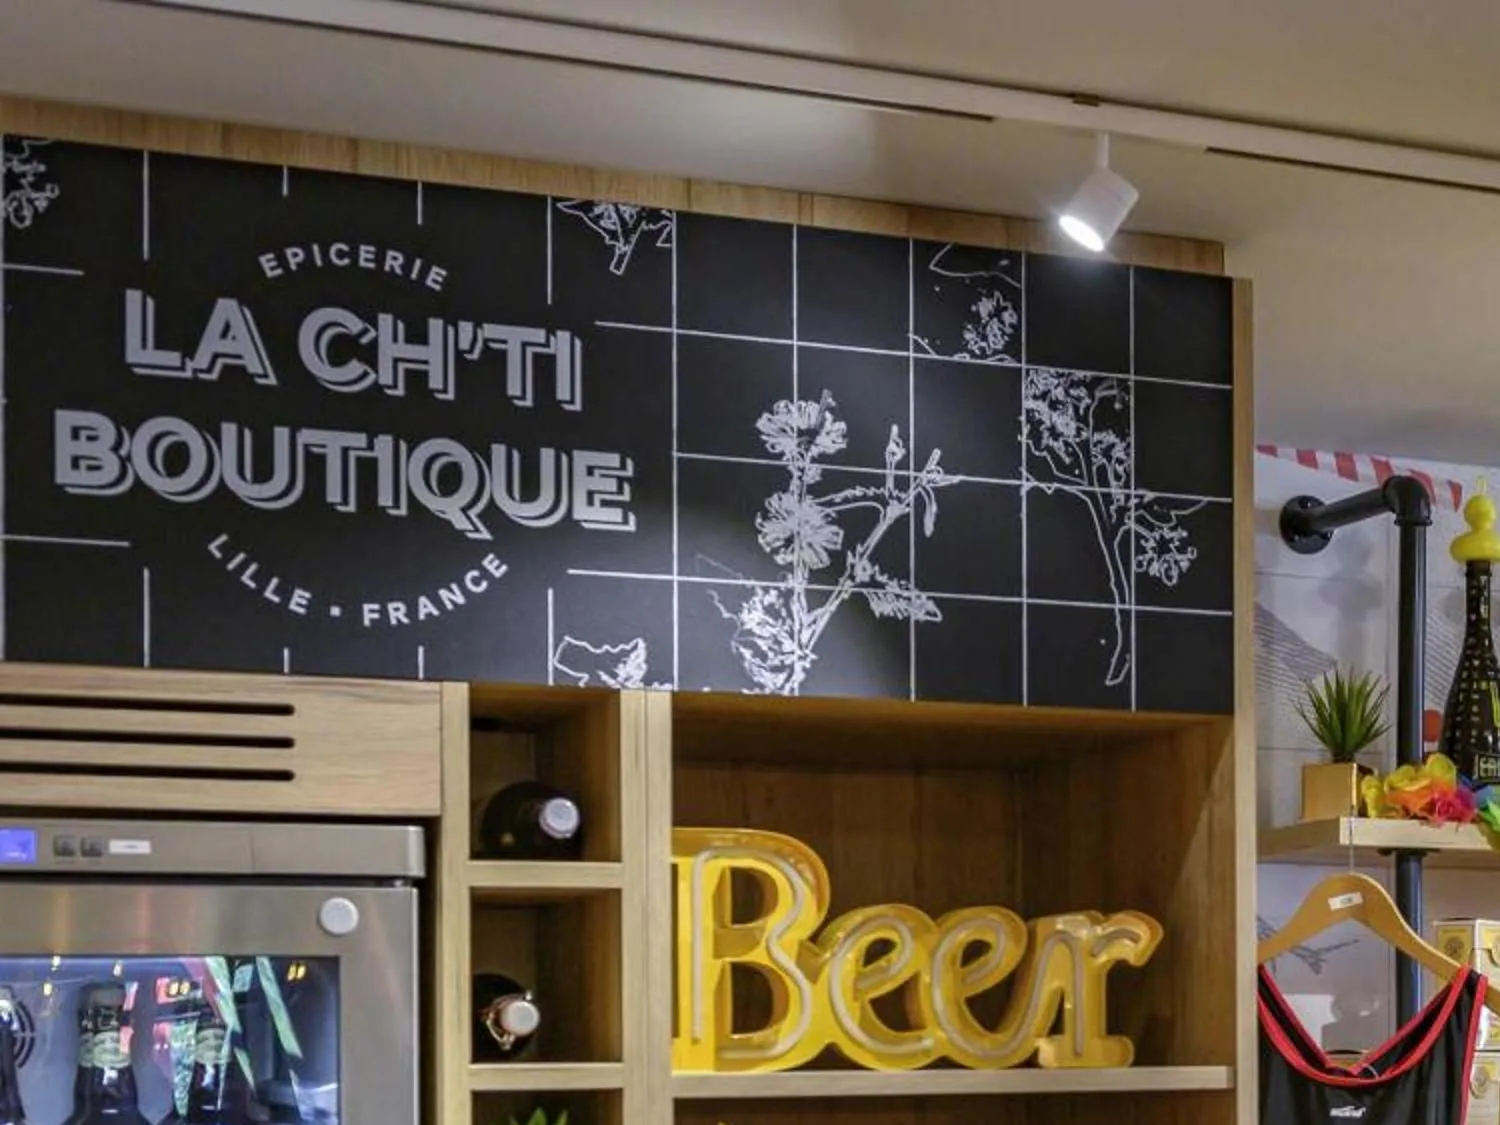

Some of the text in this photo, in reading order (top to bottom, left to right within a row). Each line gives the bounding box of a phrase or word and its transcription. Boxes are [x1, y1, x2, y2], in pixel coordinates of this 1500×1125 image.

[258, 243, 449, 291] EPICERIE
[124, 288, 583, 411] LA CH'TI
[53, 407, 638, 541] BOUTIQUE
[207, 533, 509, 628] LILLE FRANCE
[671, 826, 1165, 1073] Beer
